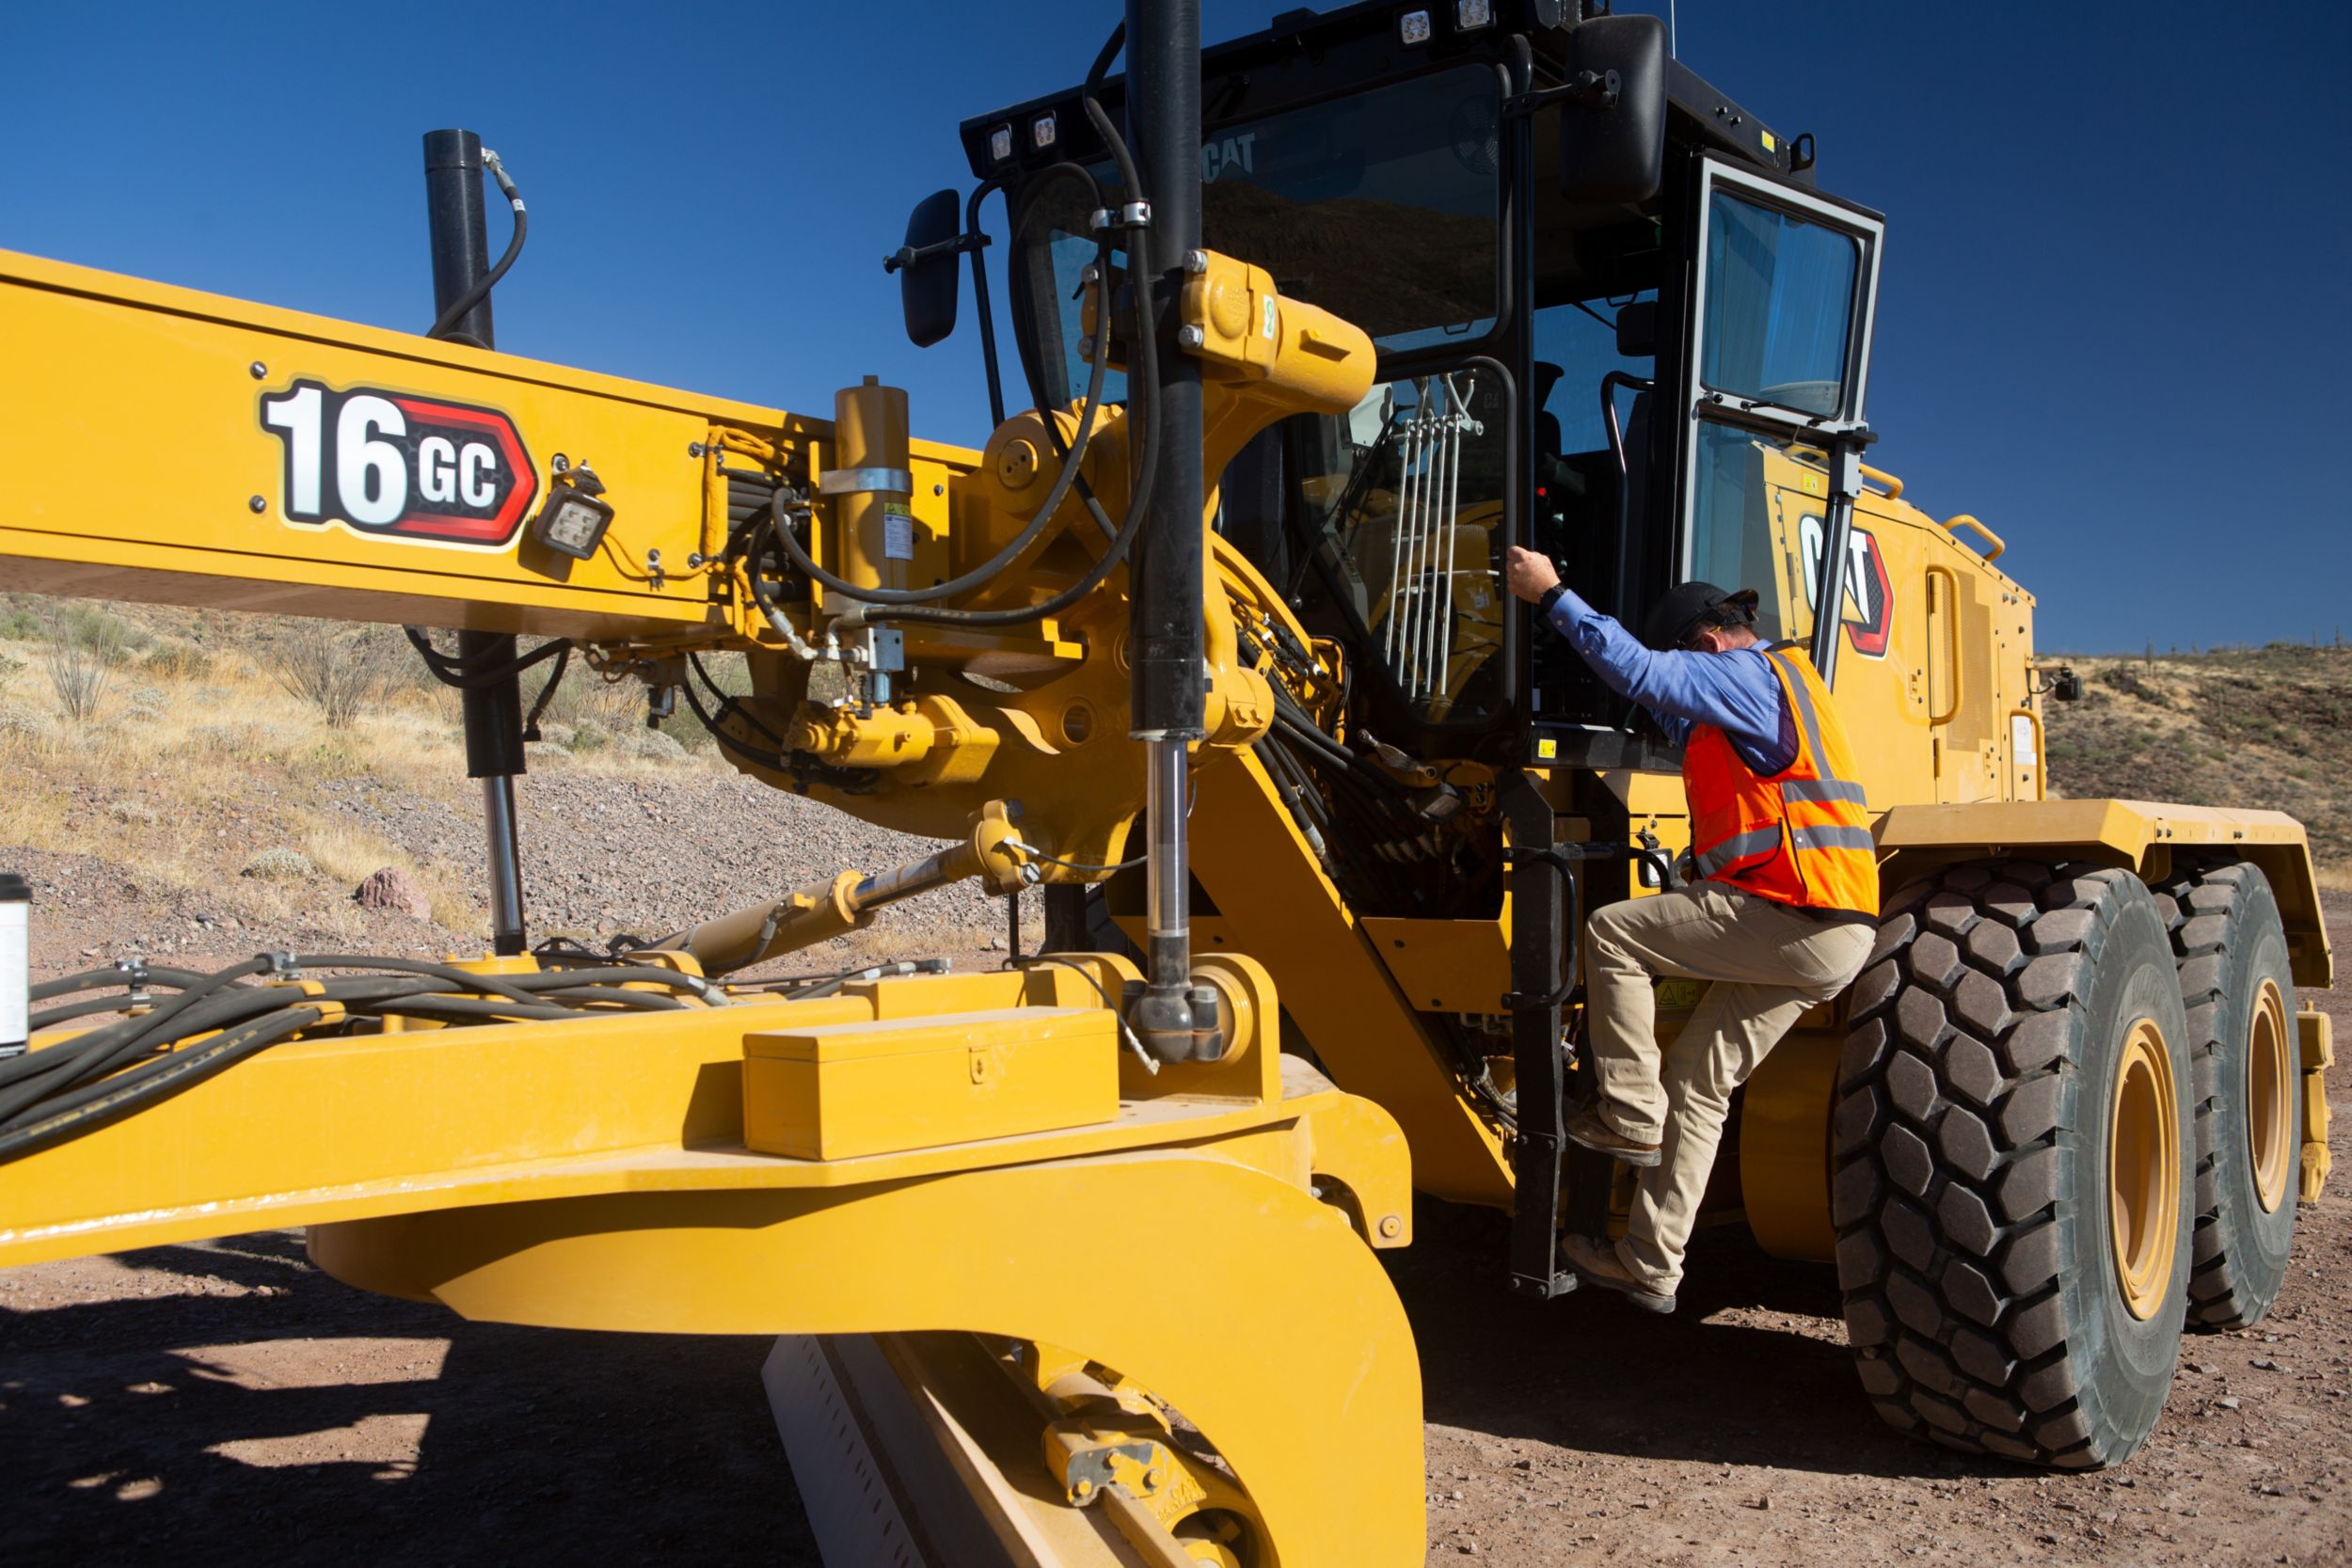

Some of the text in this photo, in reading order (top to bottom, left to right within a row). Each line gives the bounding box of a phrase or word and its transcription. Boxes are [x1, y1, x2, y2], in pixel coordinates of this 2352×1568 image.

[1201, 133, 1255, 183] CAT
[267, 387, 496, 525] 16 GC
[1801, 516, 1870, 625] CT
